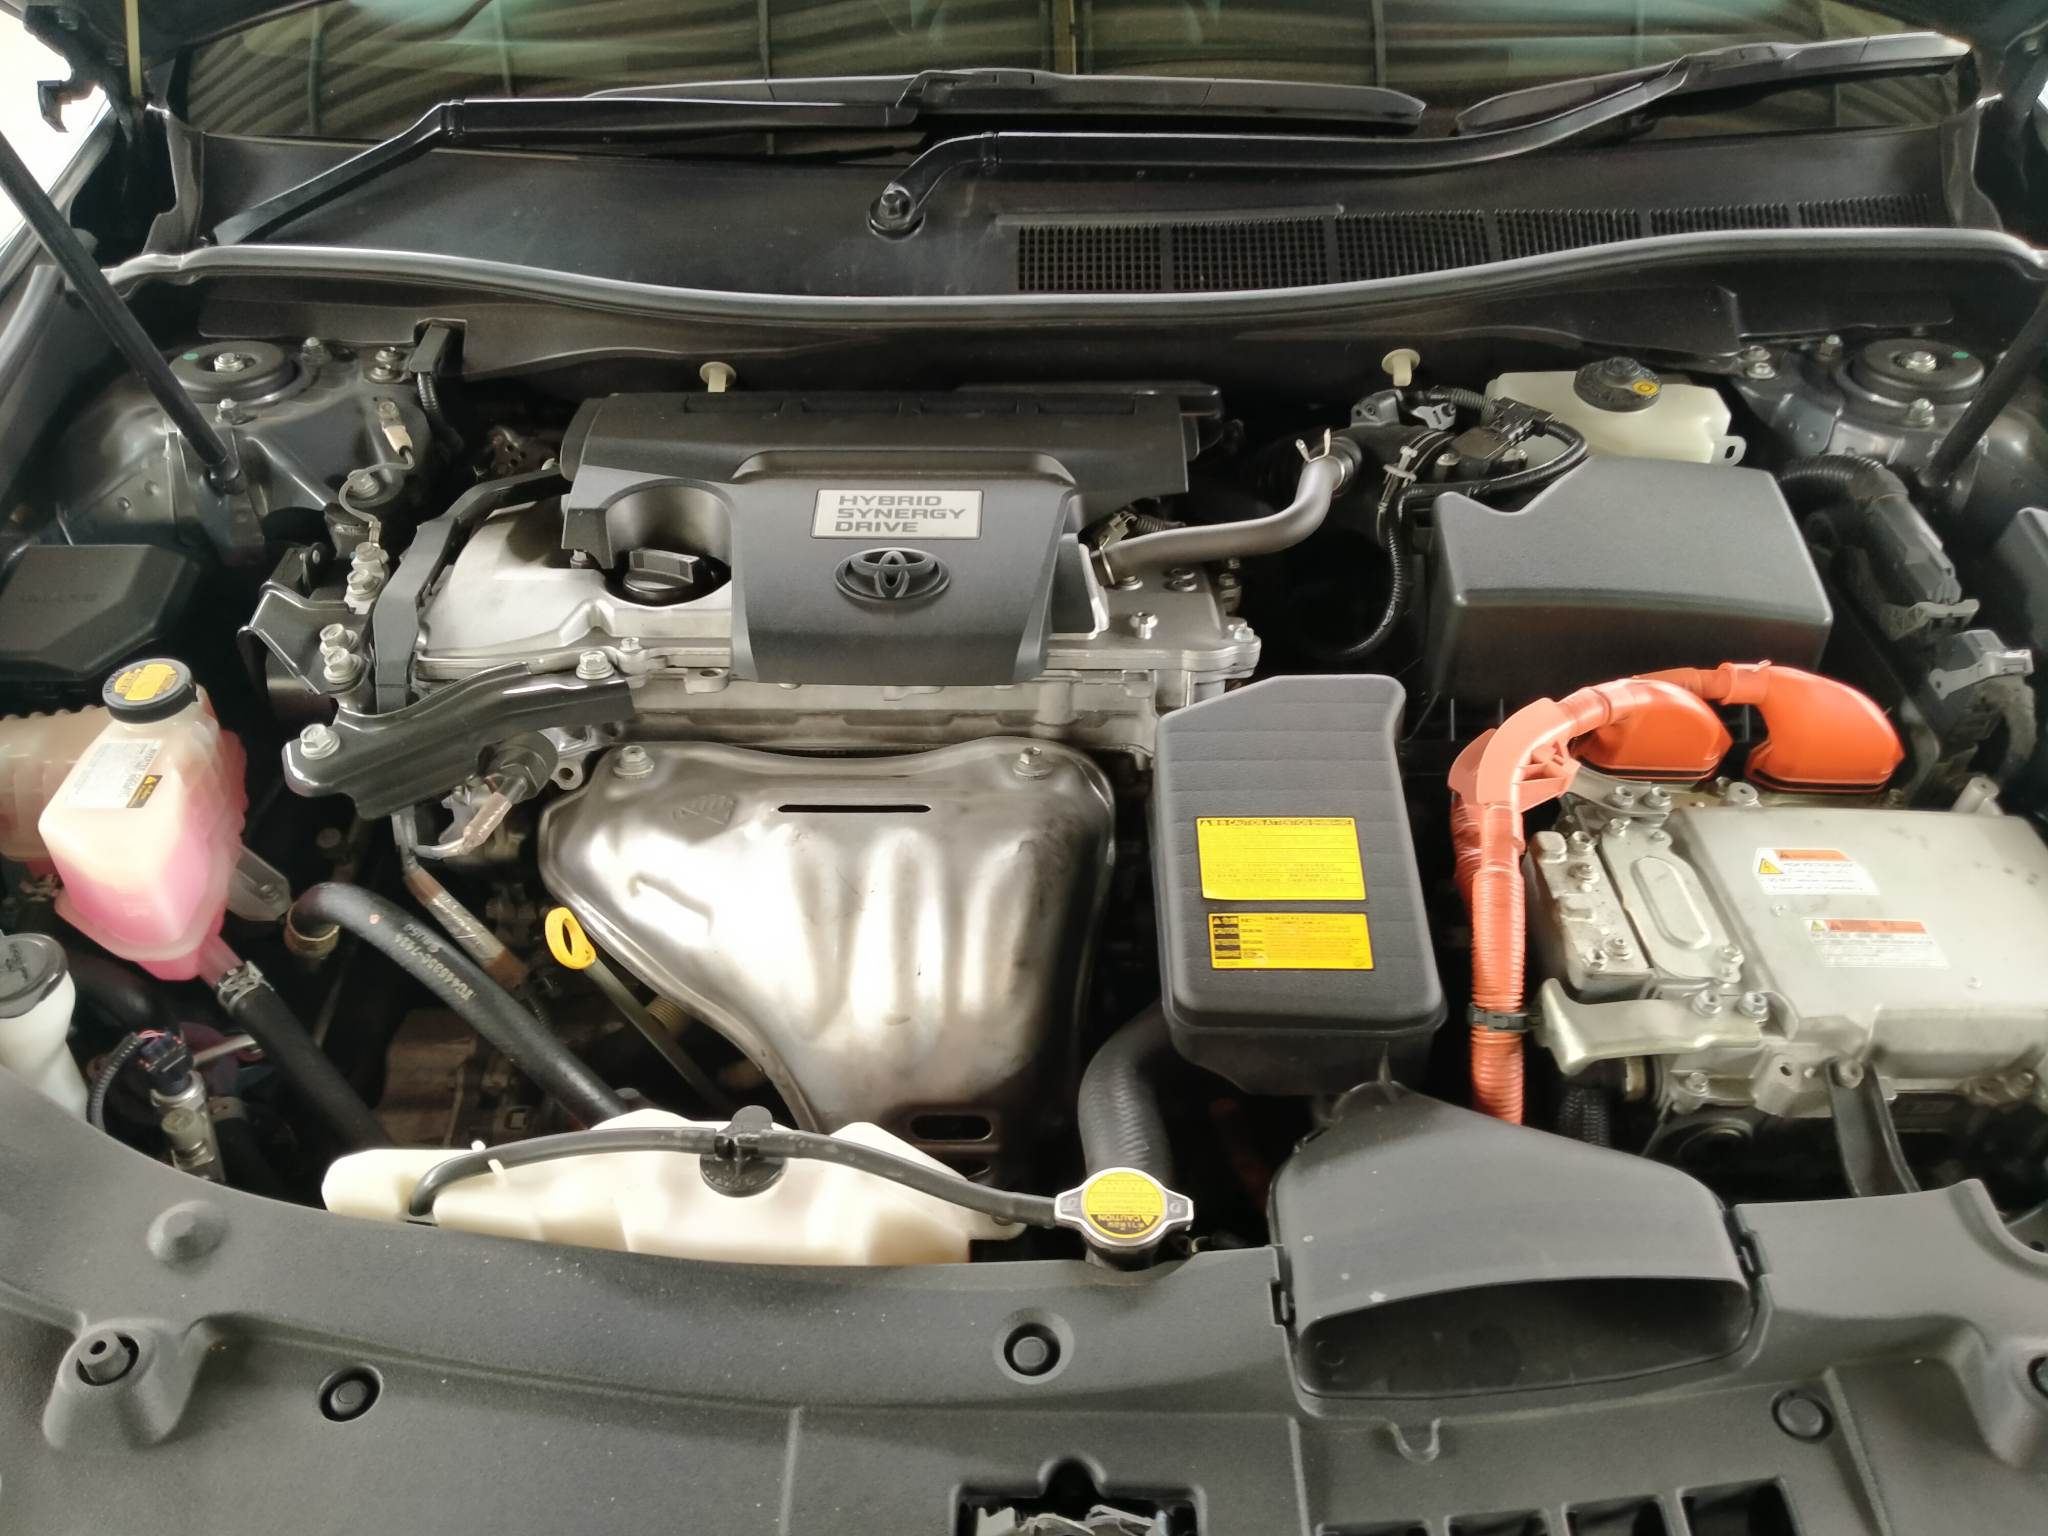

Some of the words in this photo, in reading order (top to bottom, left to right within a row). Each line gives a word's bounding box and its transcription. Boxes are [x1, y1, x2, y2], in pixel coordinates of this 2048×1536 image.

[838, 495, 942, 506] HYBRID
[836, 508, 967, 519] SYNERGY
[834, 521, 919, 532] DRIVE
[1097, 1214, 1141, 1222] CAUTION
